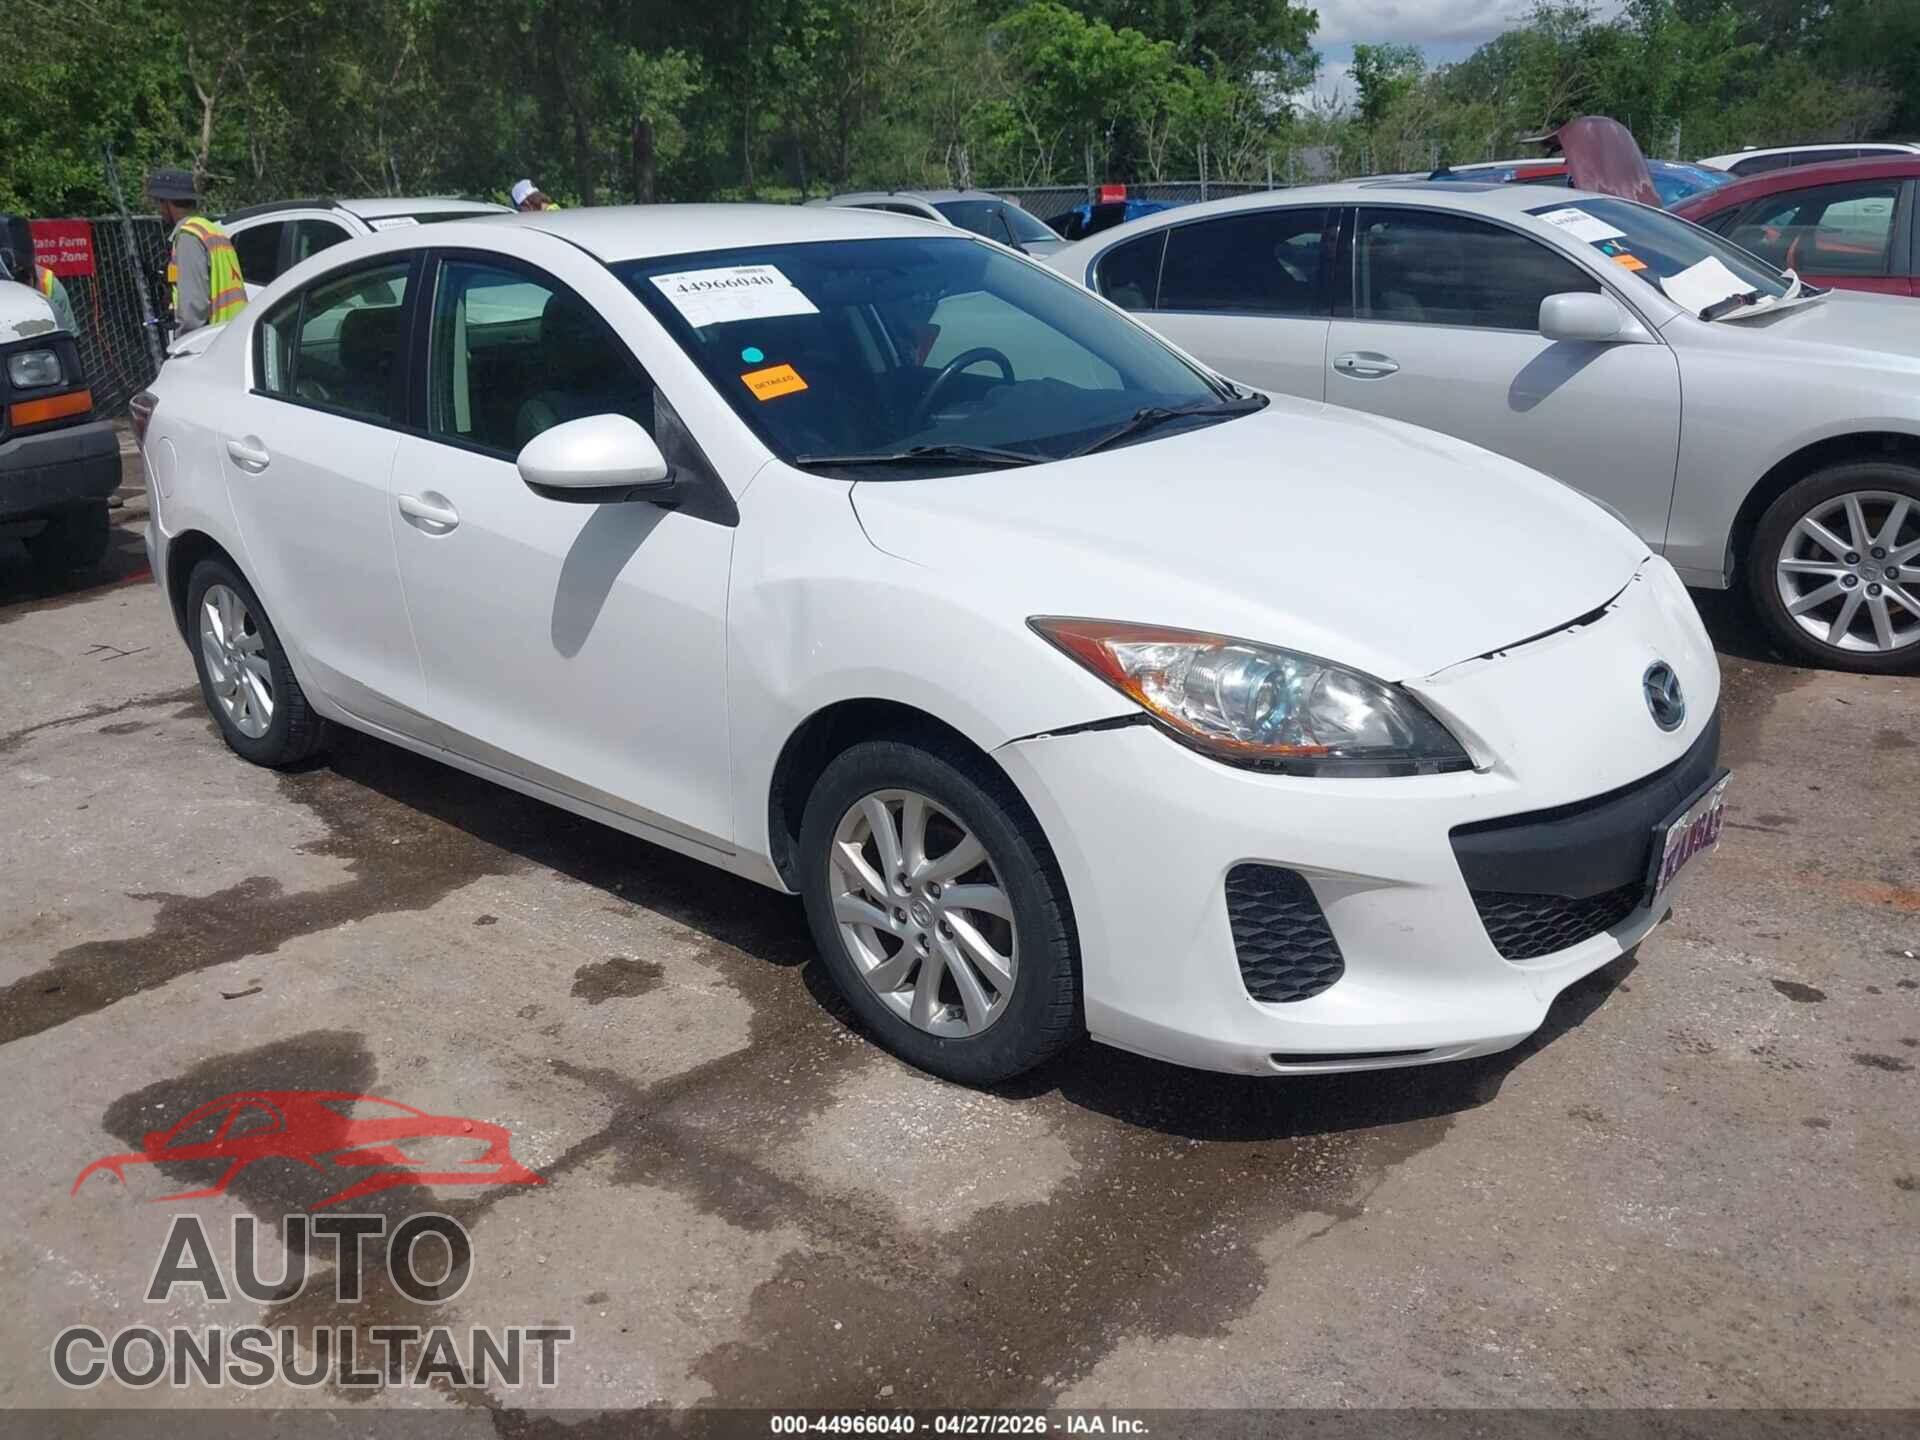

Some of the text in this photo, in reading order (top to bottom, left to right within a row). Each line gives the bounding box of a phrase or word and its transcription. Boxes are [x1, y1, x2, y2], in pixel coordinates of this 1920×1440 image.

[33, 236, 87, 248] tate Farm
[60, 251, 88, 262] Zone
[676, 275, 774, 294] 44966040
[754, 375, 794, 390] DETAILED
